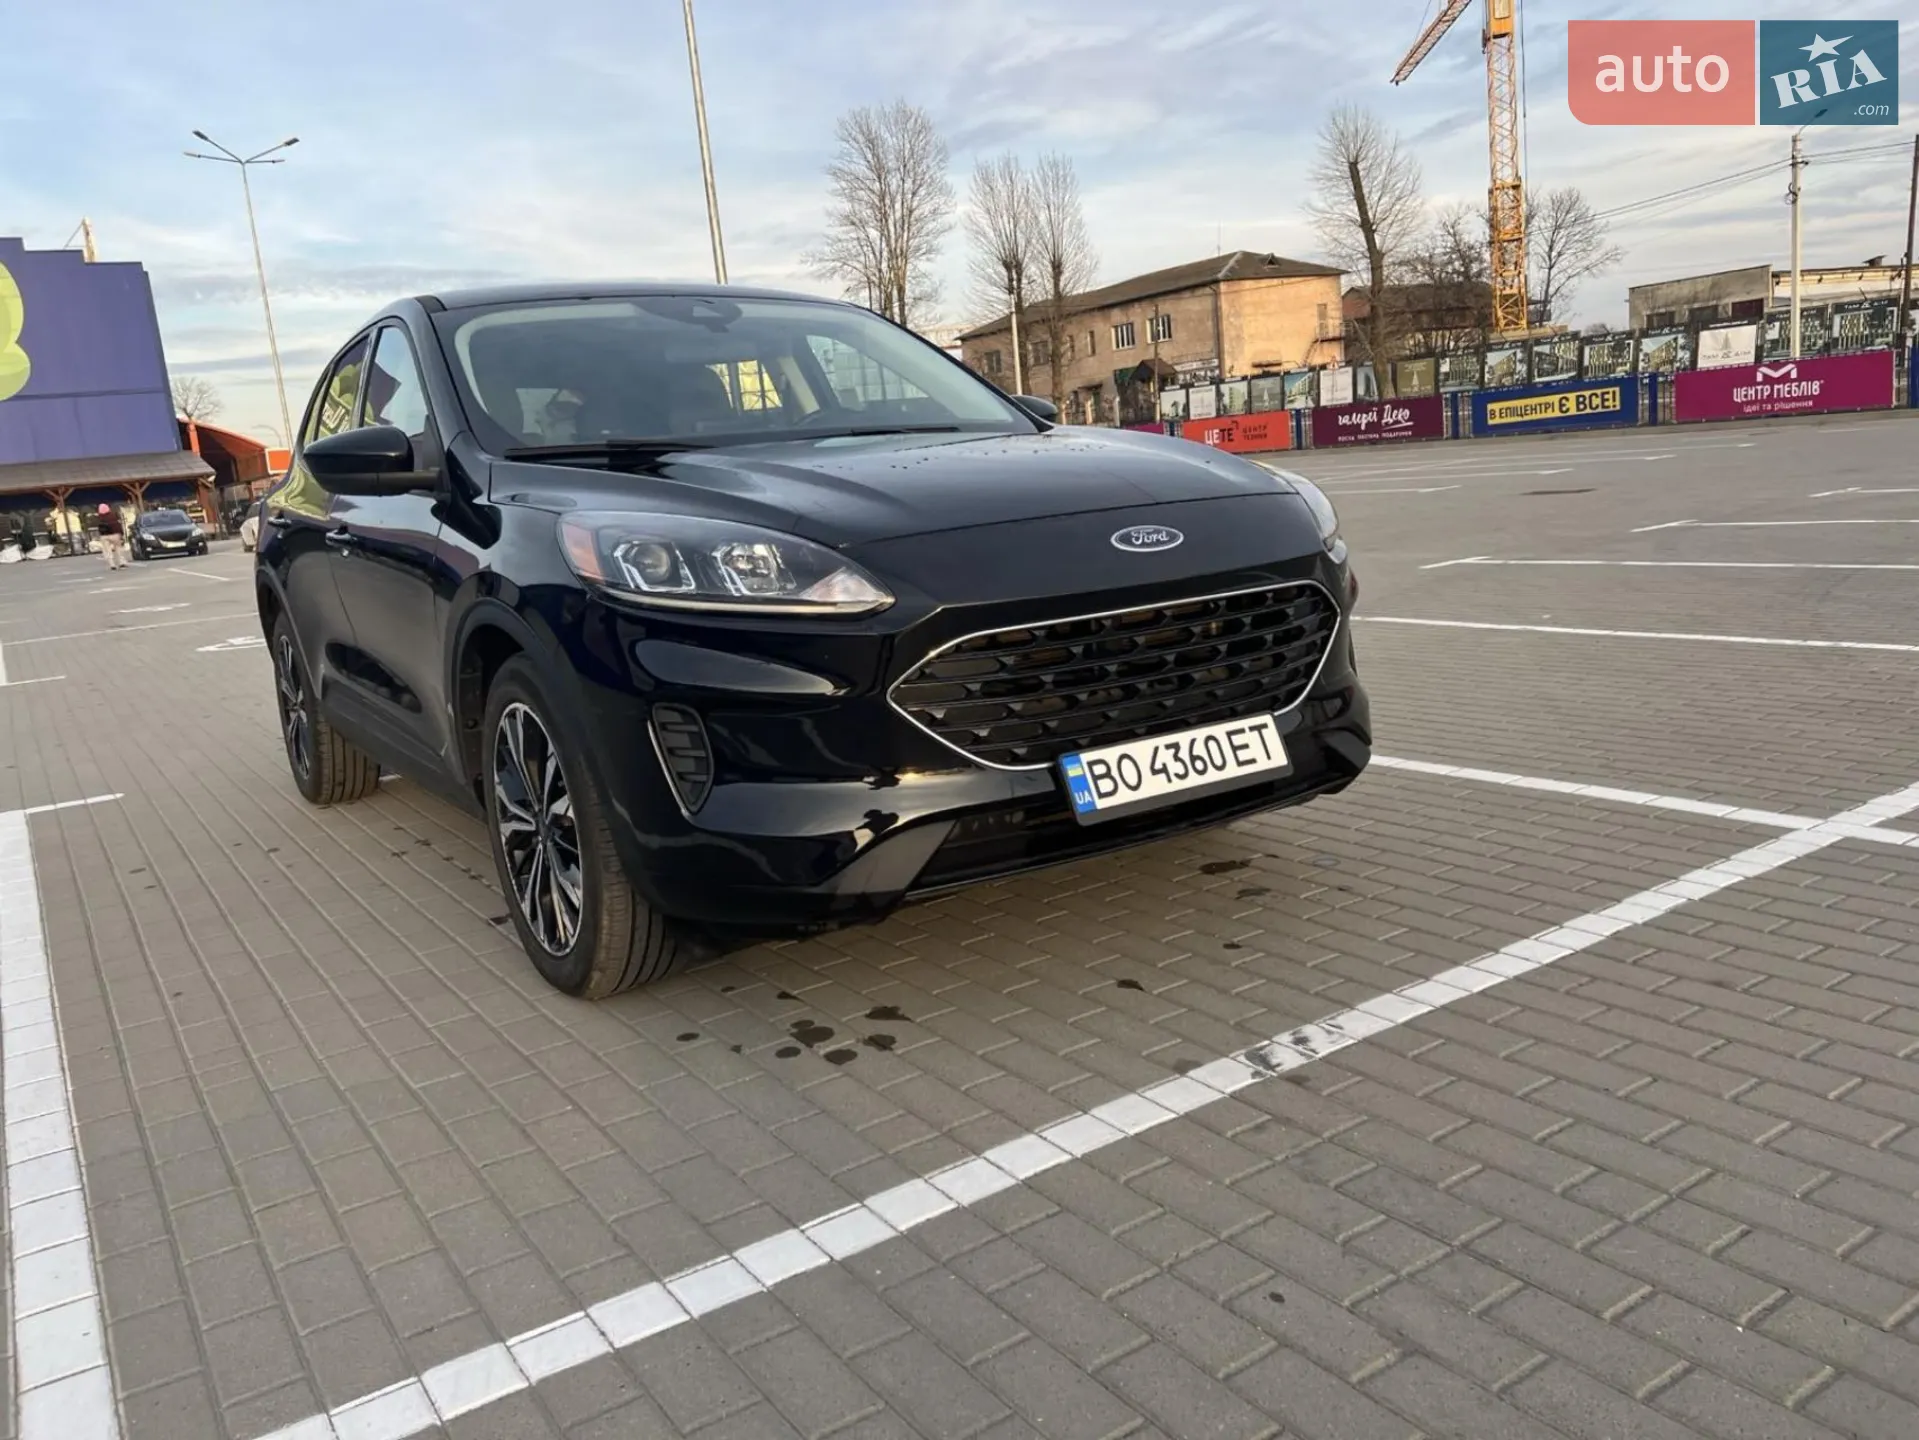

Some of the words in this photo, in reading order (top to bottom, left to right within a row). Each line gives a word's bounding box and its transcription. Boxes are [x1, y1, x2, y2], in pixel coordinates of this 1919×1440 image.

[1733, 384, 1771, 403] ЦЕНТР
[1773, 380, 1821, 399] МЕБЛІВ
[1489, 408, 1497, 420] В
[1498, 401, 1555, 419] ЕПІЦЕНТРІ
[1558, 396, 1571, 414] Є
[1575, 389, 1617, 413] ВСЕ!
[1130, 528, 1170, 545] Ford
[1075, 791, 1093, 805] UA
